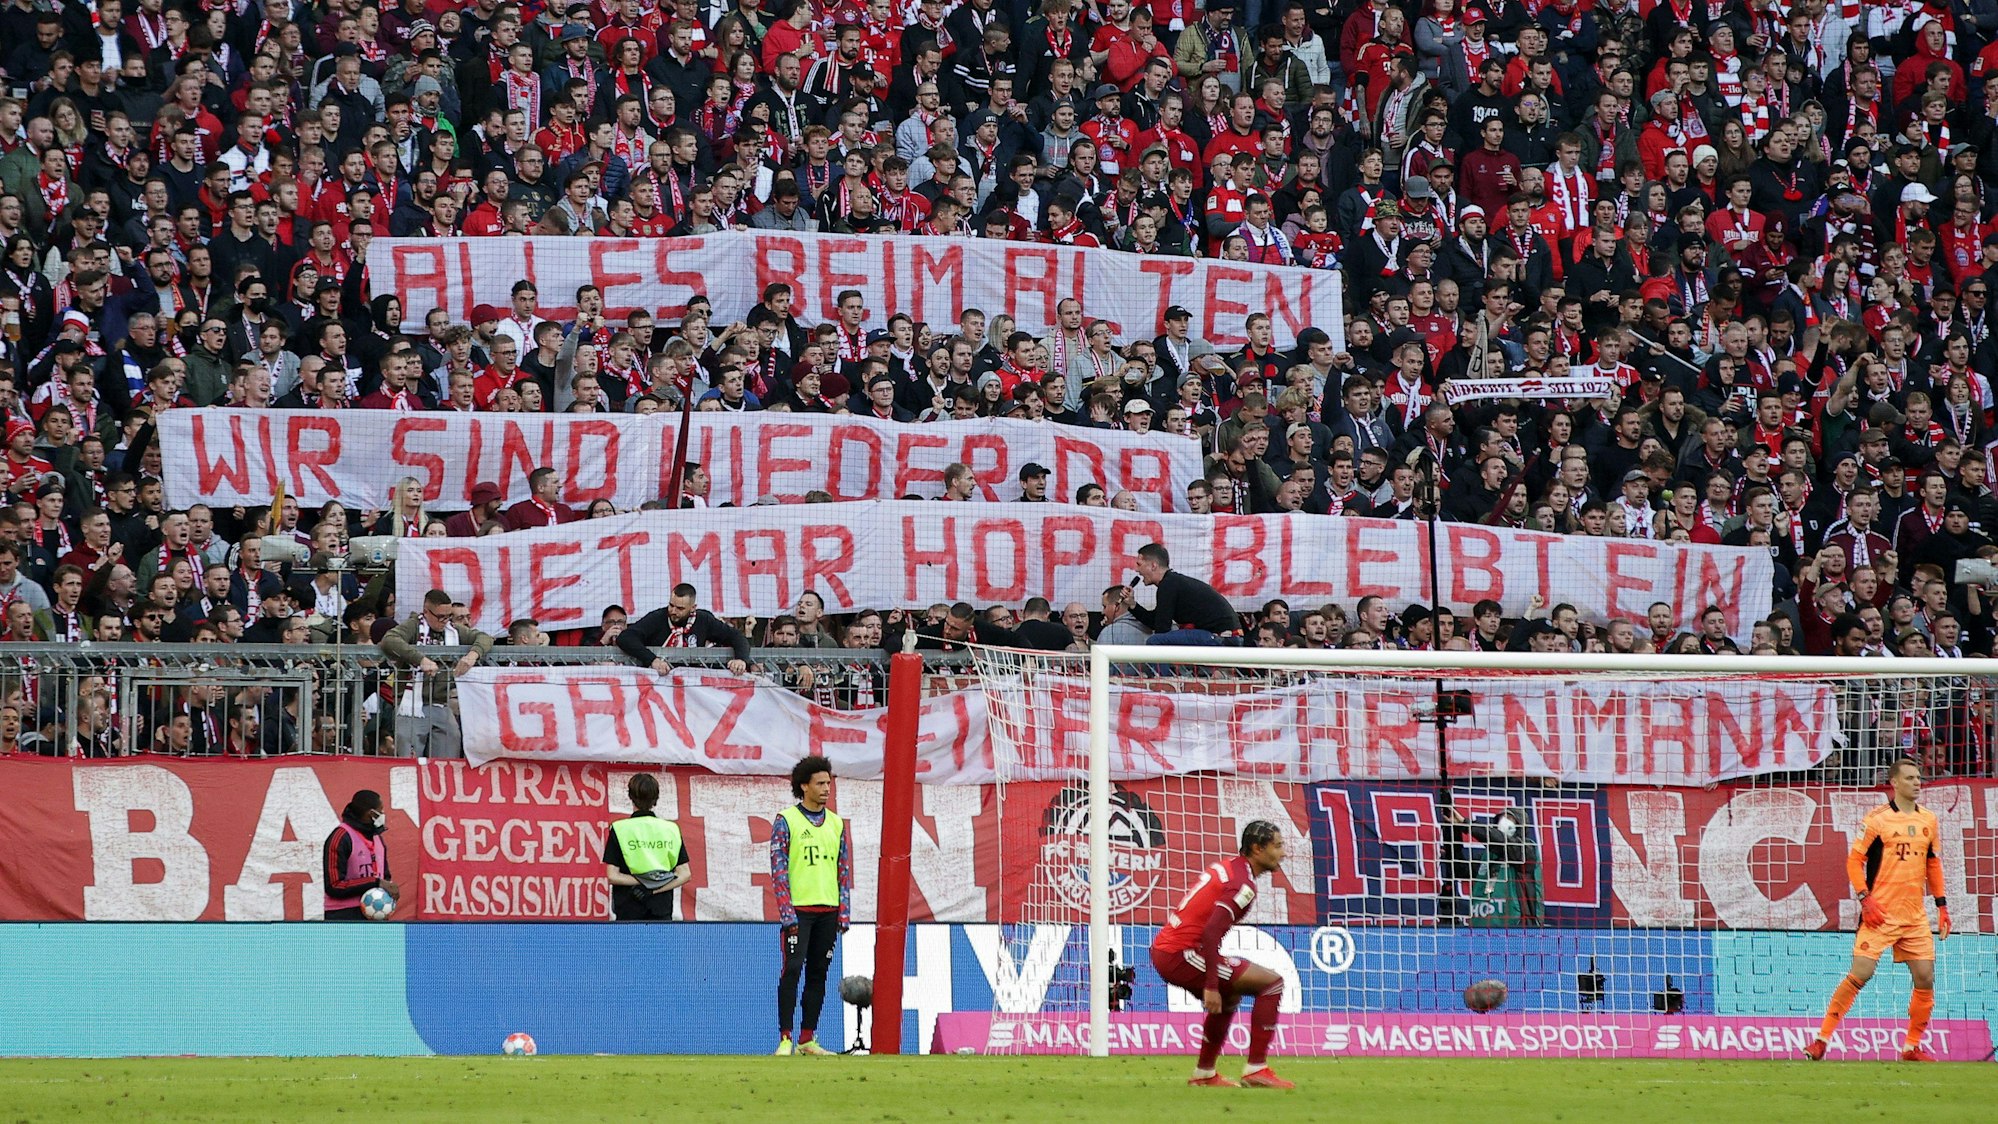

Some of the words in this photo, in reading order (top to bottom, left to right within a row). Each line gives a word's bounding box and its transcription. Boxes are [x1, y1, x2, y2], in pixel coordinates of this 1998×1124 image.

[392, 237, 708, 322] ALLES
[755, 235, 965, 324] BEIM
[1004, 247, 1313, 346] ALTEN
[1548, 382, 1576, 394] SEIT
[1581, 381, 1611, 394] 1972
[191, 414, 341, 498] WIR
[388, 417, 621, 503] SIND
[1053, 434, 1174, 513] DA
[426, 524, 855, 628] DIETMAR
[901, 515, 1165, 602] HOPP
[1210, 514, 1565, 610] BLEIBT
[1604, 542, 1746, 637] EIN
[495, 674, 763, 760] GANZ
[1228, 685, 1830, 778] EHRENMANN
[420, 760, 607, 807] ULTRAS
[421, 815, 610, 865] GEGEN
[1045, 840, 1070, 862] FC
[1075, 841, 1161, 872] BYERN
[422, 873, 610, 918] RASSISMUS
[1357, 1024, 1517, 1051] MAGENTA
[1521, 1025, 1621, 1051] SPORT
